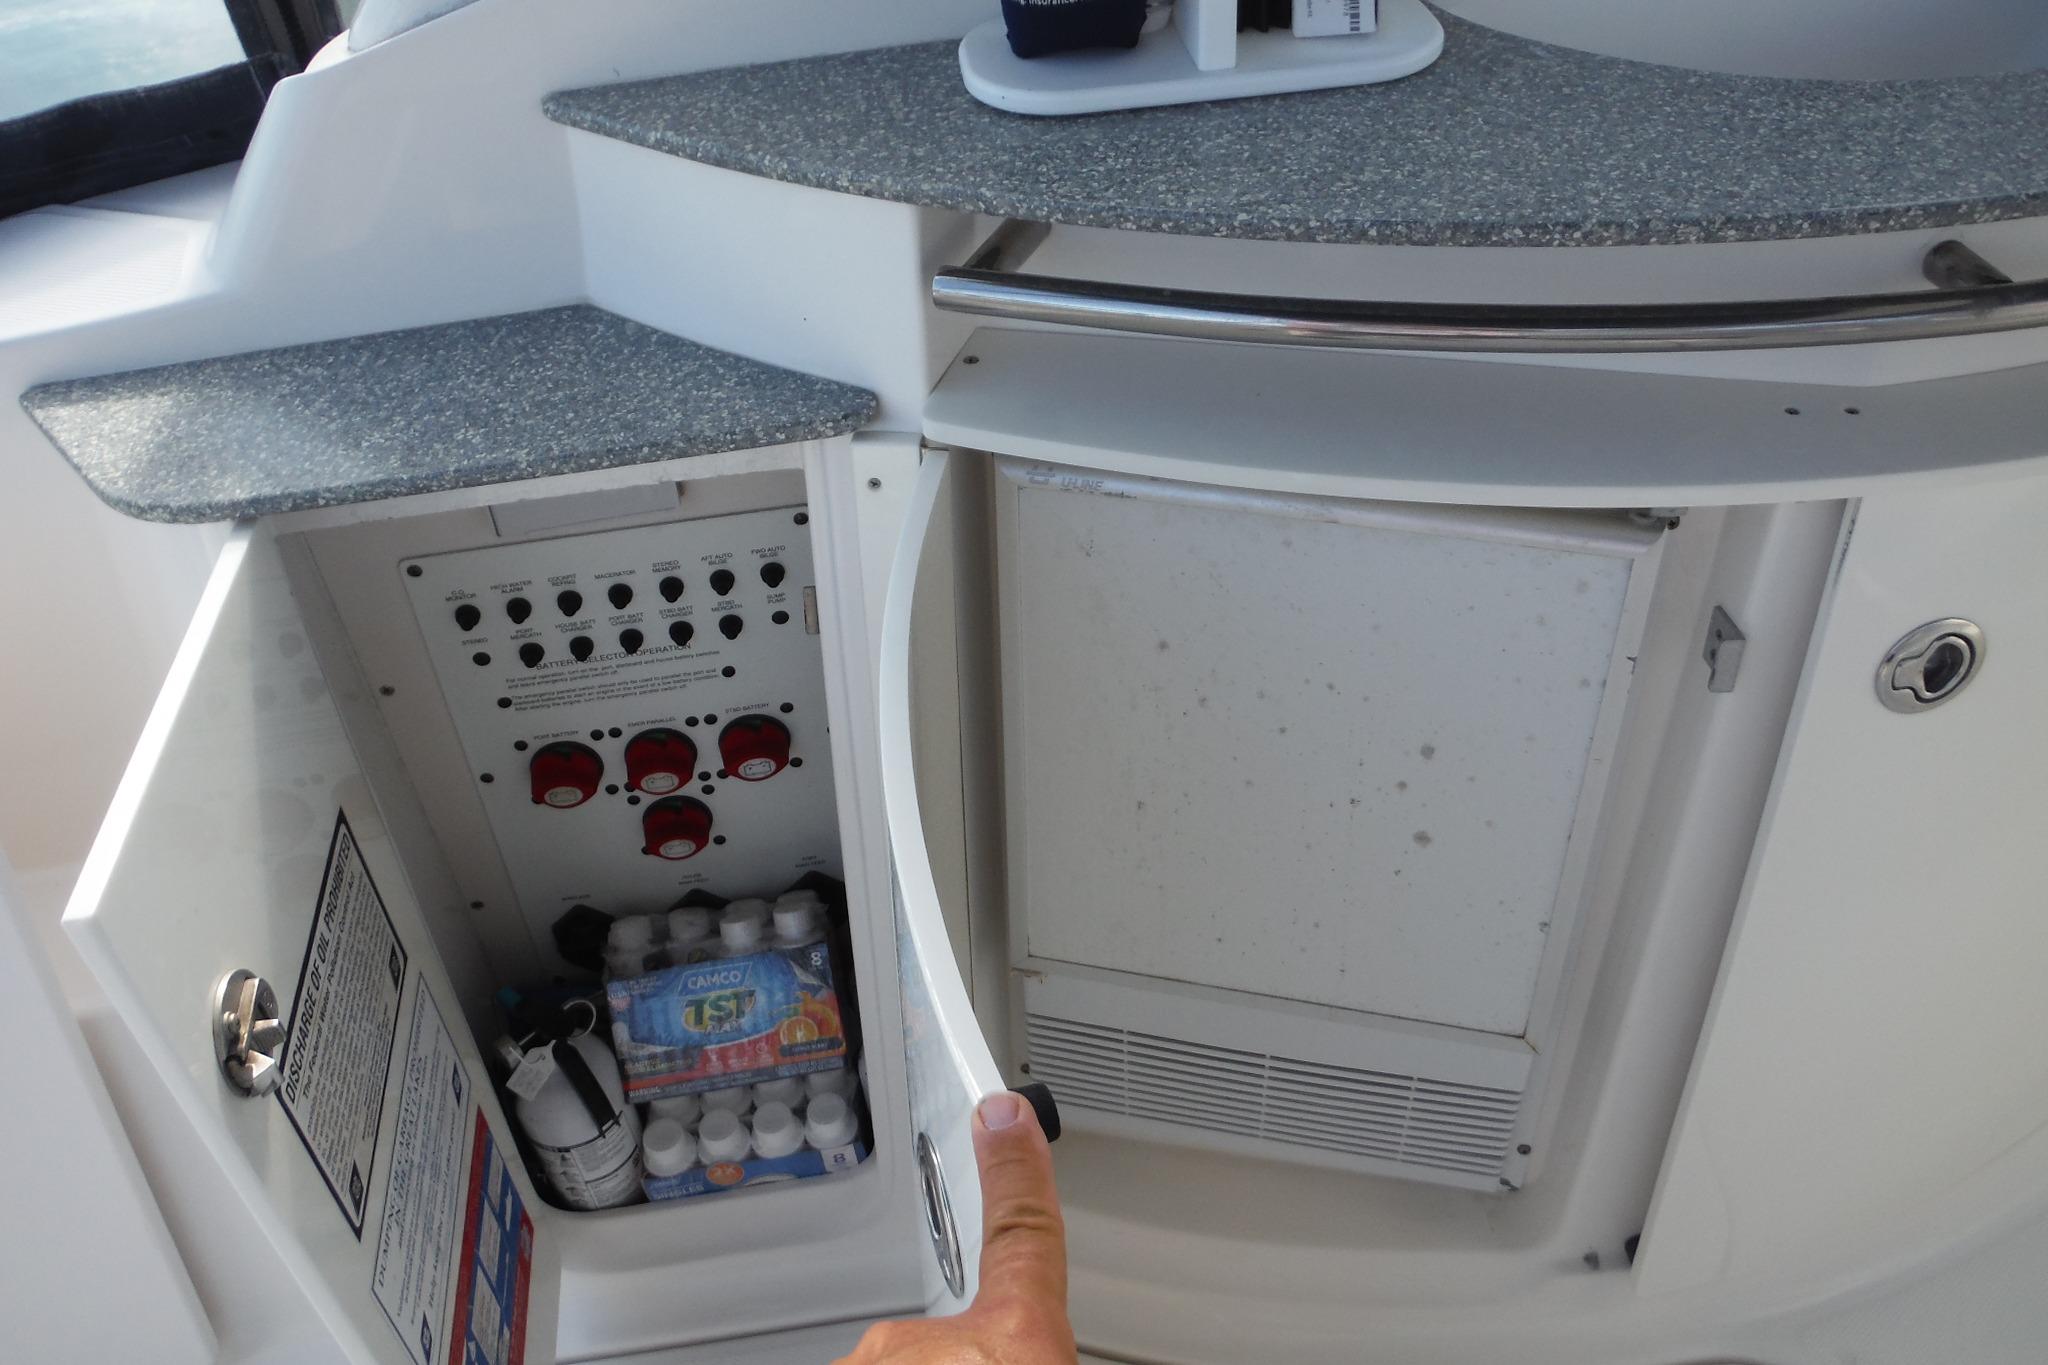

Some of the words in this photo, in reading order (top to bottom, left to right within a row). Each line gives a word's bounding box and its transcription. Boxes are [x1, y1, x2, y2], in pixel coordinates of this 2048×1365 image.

[594, 570, 635, 579] MACERATOR
[536, 658, 578, 671] BATTERY
[635, 642, 691, 657] OPERATION
[286, 987, 316, 1103] DISCHARGE
[310, 958, 321, 991] OF
[317, 932, 329, 964] OIL
[324, 833, 350, 932] PROHIBITED
[811, 951, 823, 966] 8
[302, 1074, 312, 1099] The
[308, 1022, 322, 1073] Federal
[319, 987, 330, 1023] Water
[327, 934, 341, 985] Pollution
[338, 889, 350, 933] Control
[687, 970, 742, 989] CAMCO
[685, 989, 756, 1026] TST
[378, 1197, 395, 1287] DUMPING
[393, 1170, 399, 1192] OF
[397, 1086, 412, 1165] GARBAGE
[409, 989, 425, 1080] PROHIBITED
[395, 1208, 401, 1226] IN
[398, 1169, 406, 1199] THE
[404, 1110, 414, 1164] GREAT
[411, 1057, 422, 1106] LAKES
